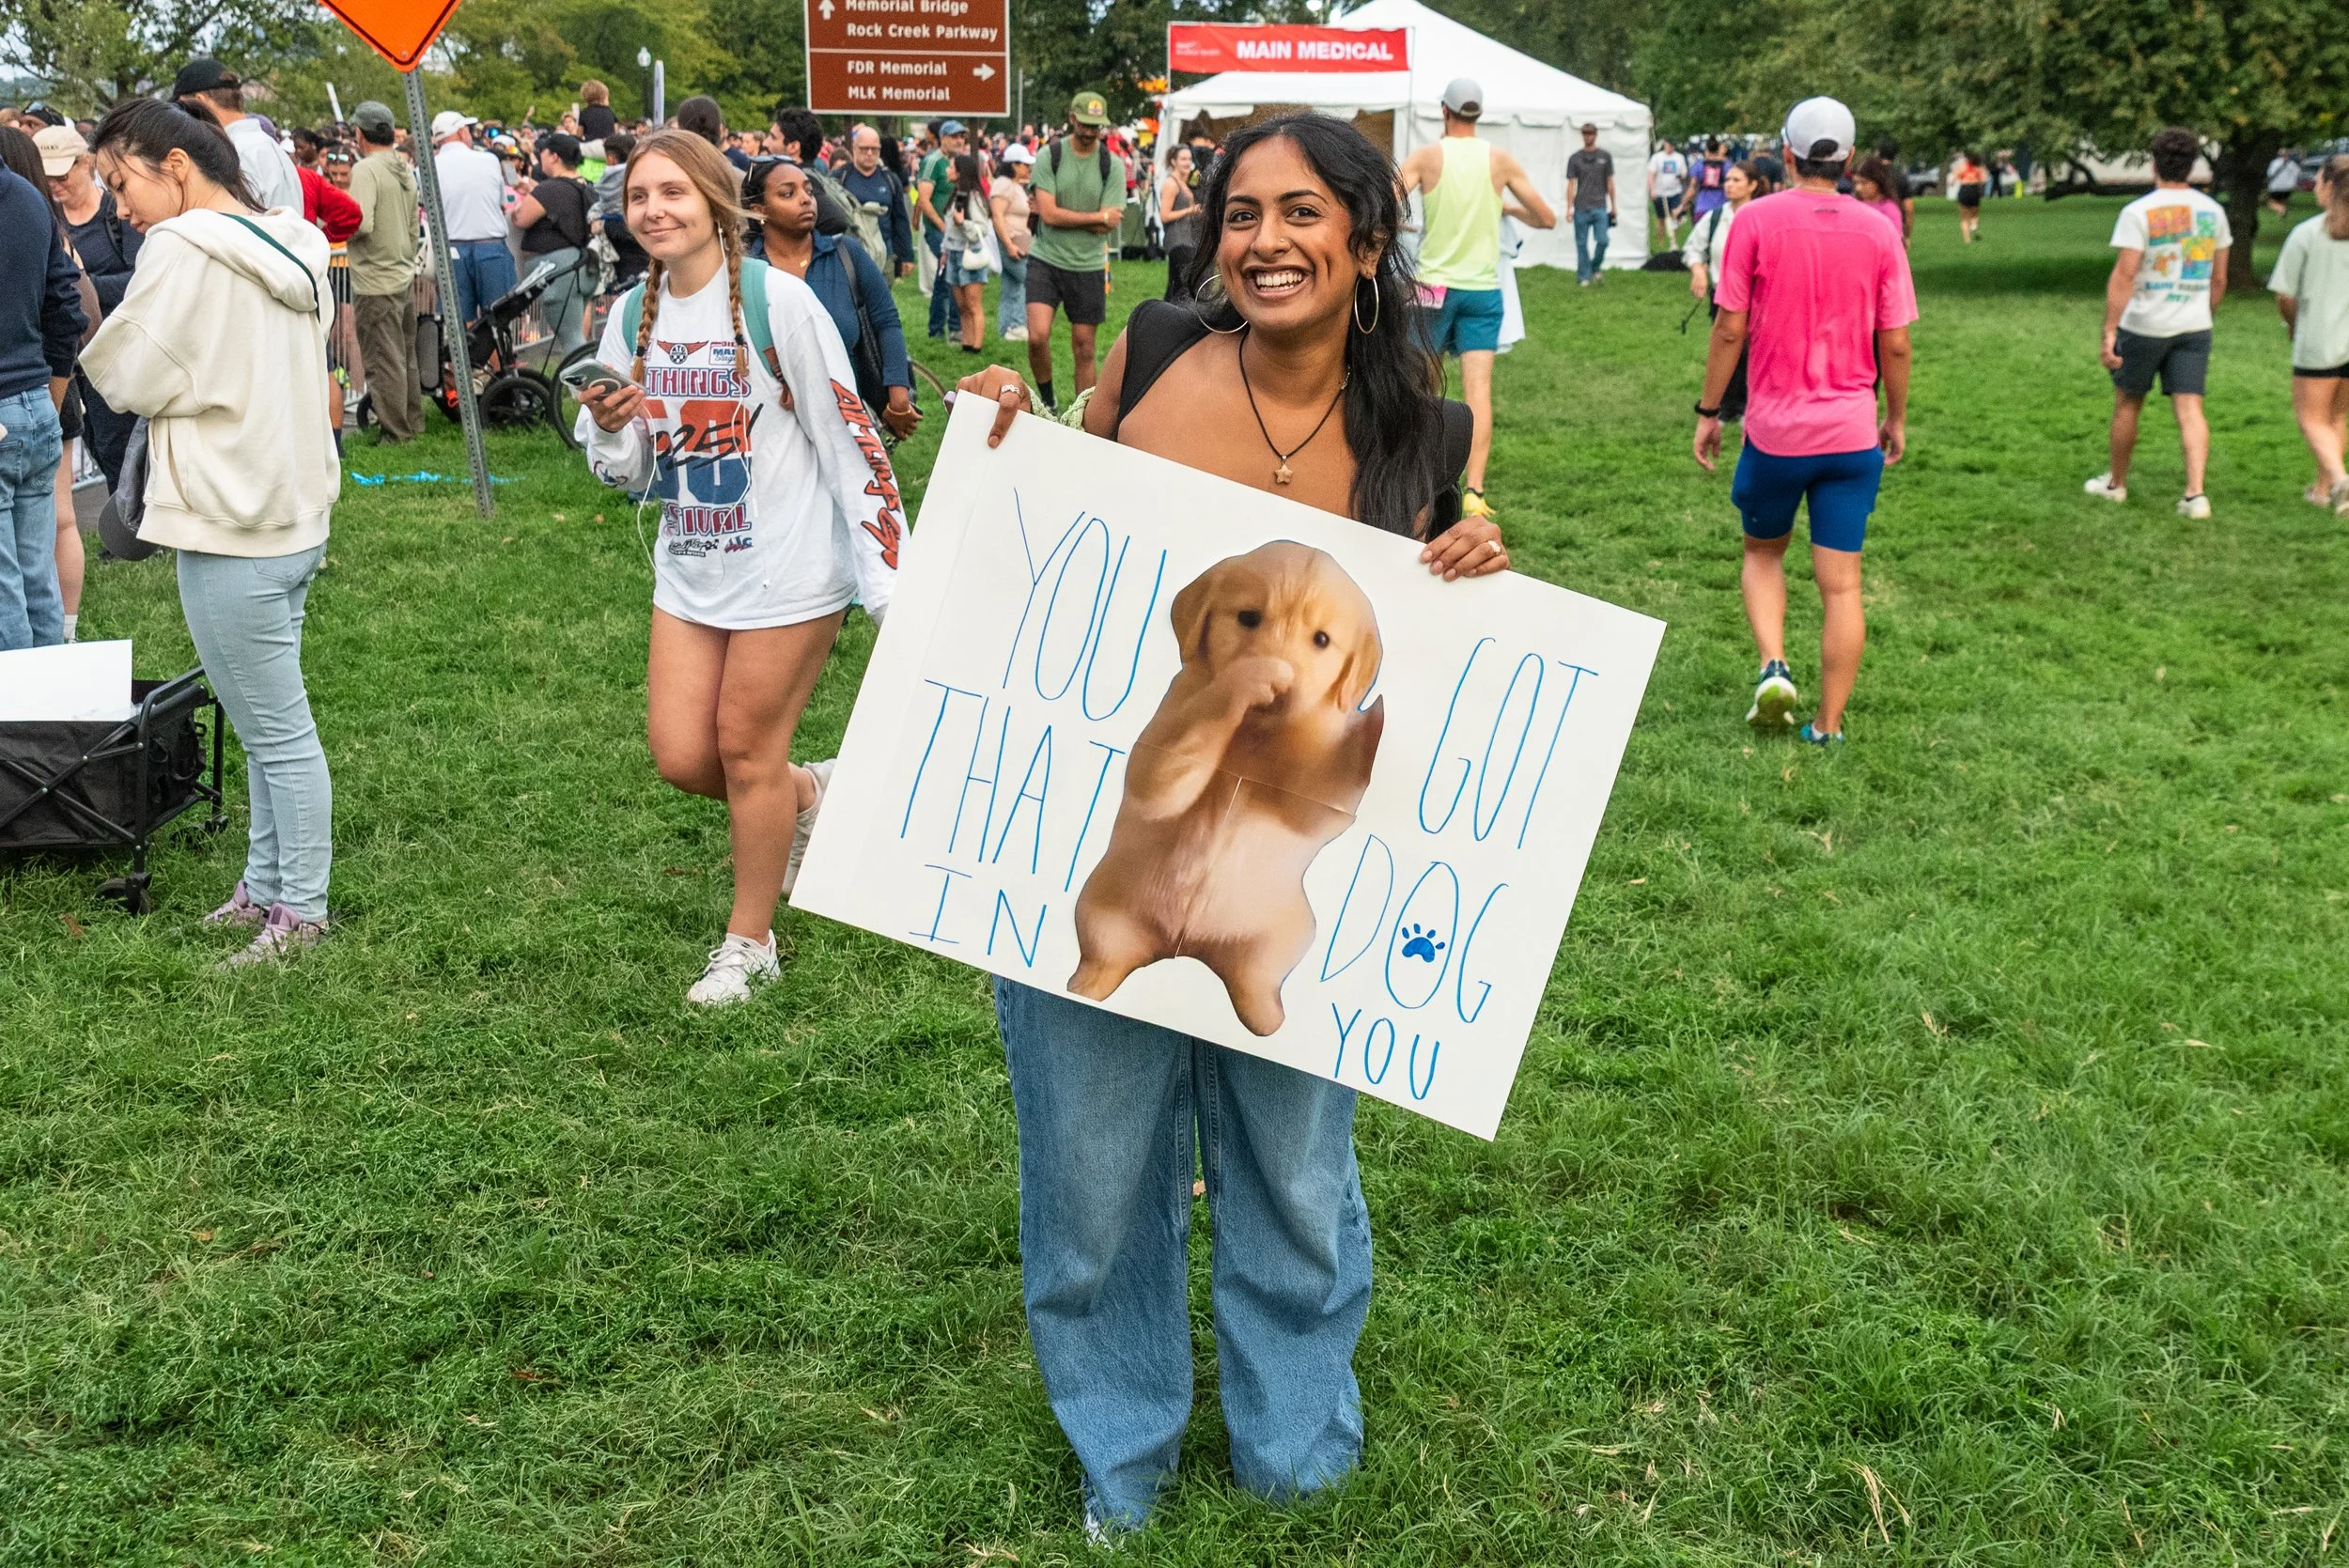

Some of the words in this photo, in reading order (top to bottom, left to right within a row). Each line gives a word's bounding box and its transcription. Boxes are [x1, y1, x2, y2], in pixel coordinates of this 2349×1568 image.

[846, 0, 914, 12] Memorial
[920, 0, 969, 16] Bridge
[847, 23, 882, 38] Rock
[888, 23, 930, 39] Creek
[936, 24, 998, 42] Parkway
[1237, 40, 1292, 59] MAIN
[1298, 41, 1393, 60] MEDICAL
[847, 60, 875, 74] FDR
[880, 61, 947, 75] Memorial
[848, 86, 877, 100] MLK
[882, 86, 950, 101] Memorial
[1003, 487, 1167, 722] YOU
[1419, 637, 1600, 849] GOT
[900, 679, 1127, 893] THAT
[1319, 834, 1509, 1024] DOG
[908, 864, 1048, 968] IN
[1331, 1002, 1440, 1100] YOU
